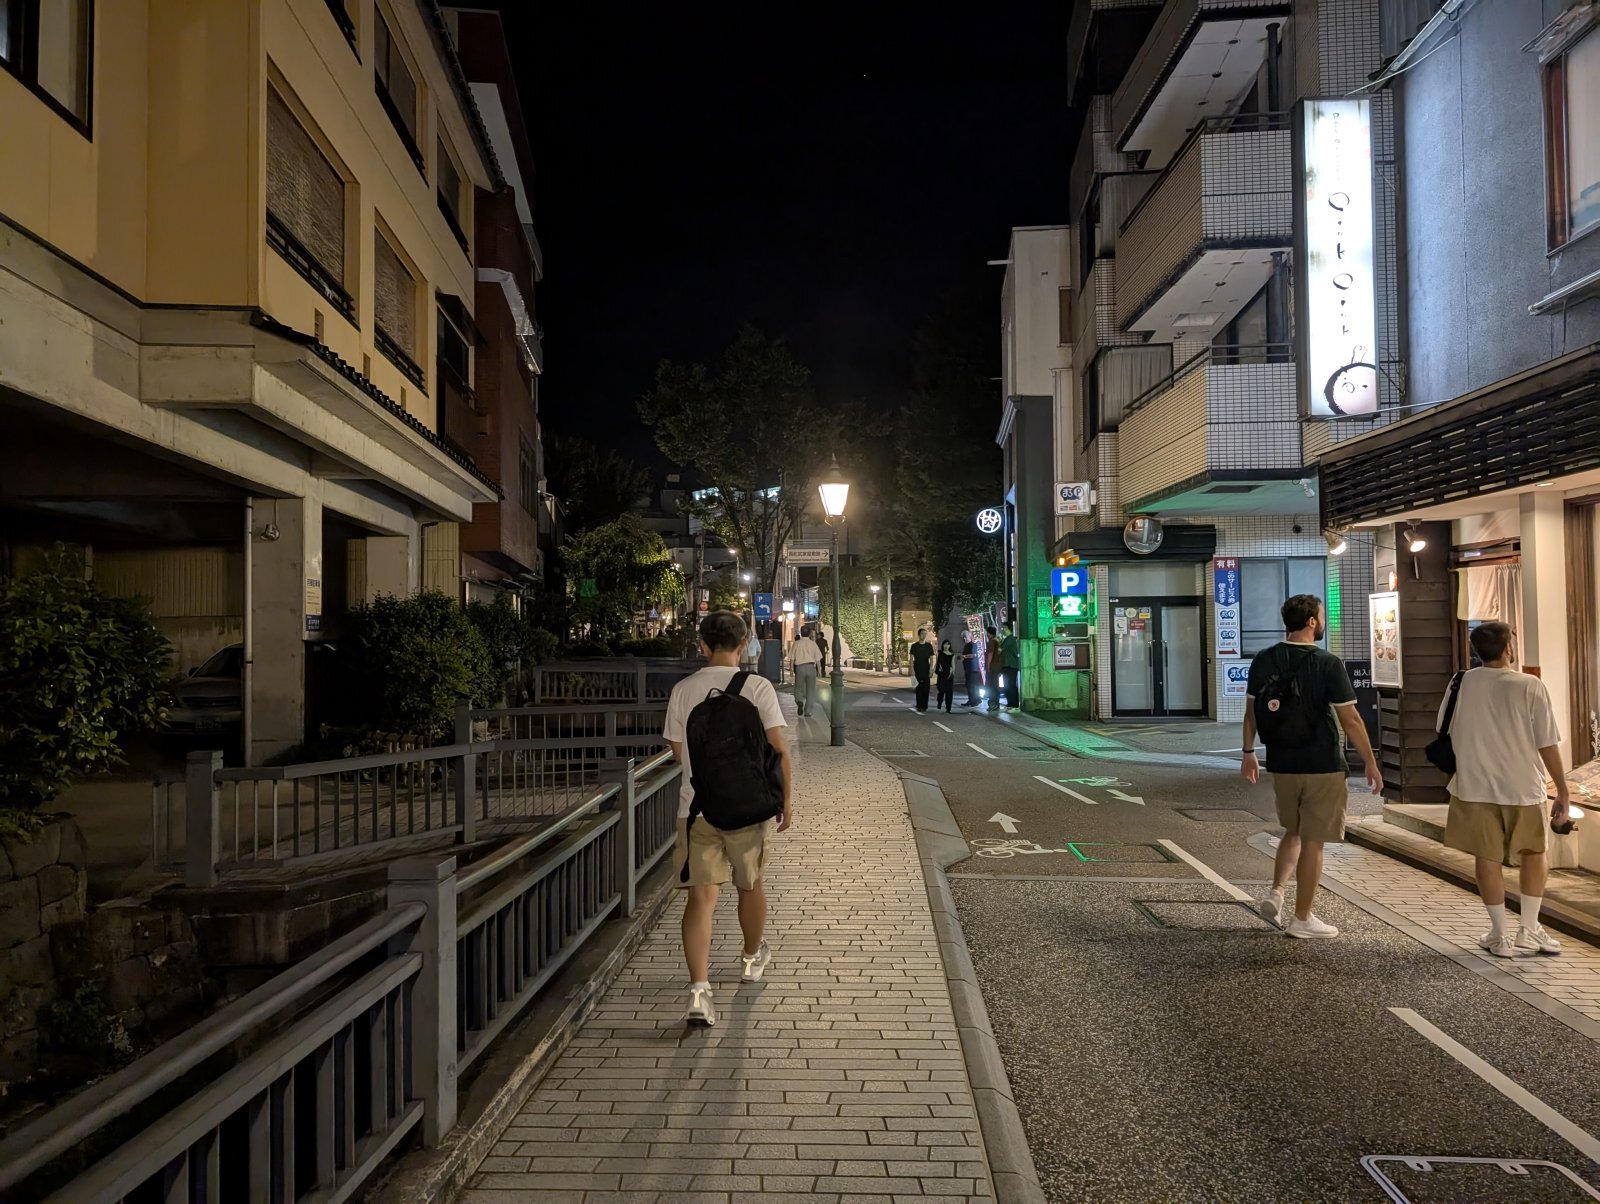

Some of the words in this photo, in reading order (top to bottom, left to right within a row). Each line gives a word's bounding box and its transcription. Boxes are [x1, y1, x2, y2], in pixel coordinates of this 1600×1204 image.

[1216, 559, 1235, 569] 有料
[1061, 572, 1079, 593] P
[1059, 594, 1082, 616] 空
[1353, 668, 1370, 676] 出入
[1353, 678, 1371, 688] 歩行
